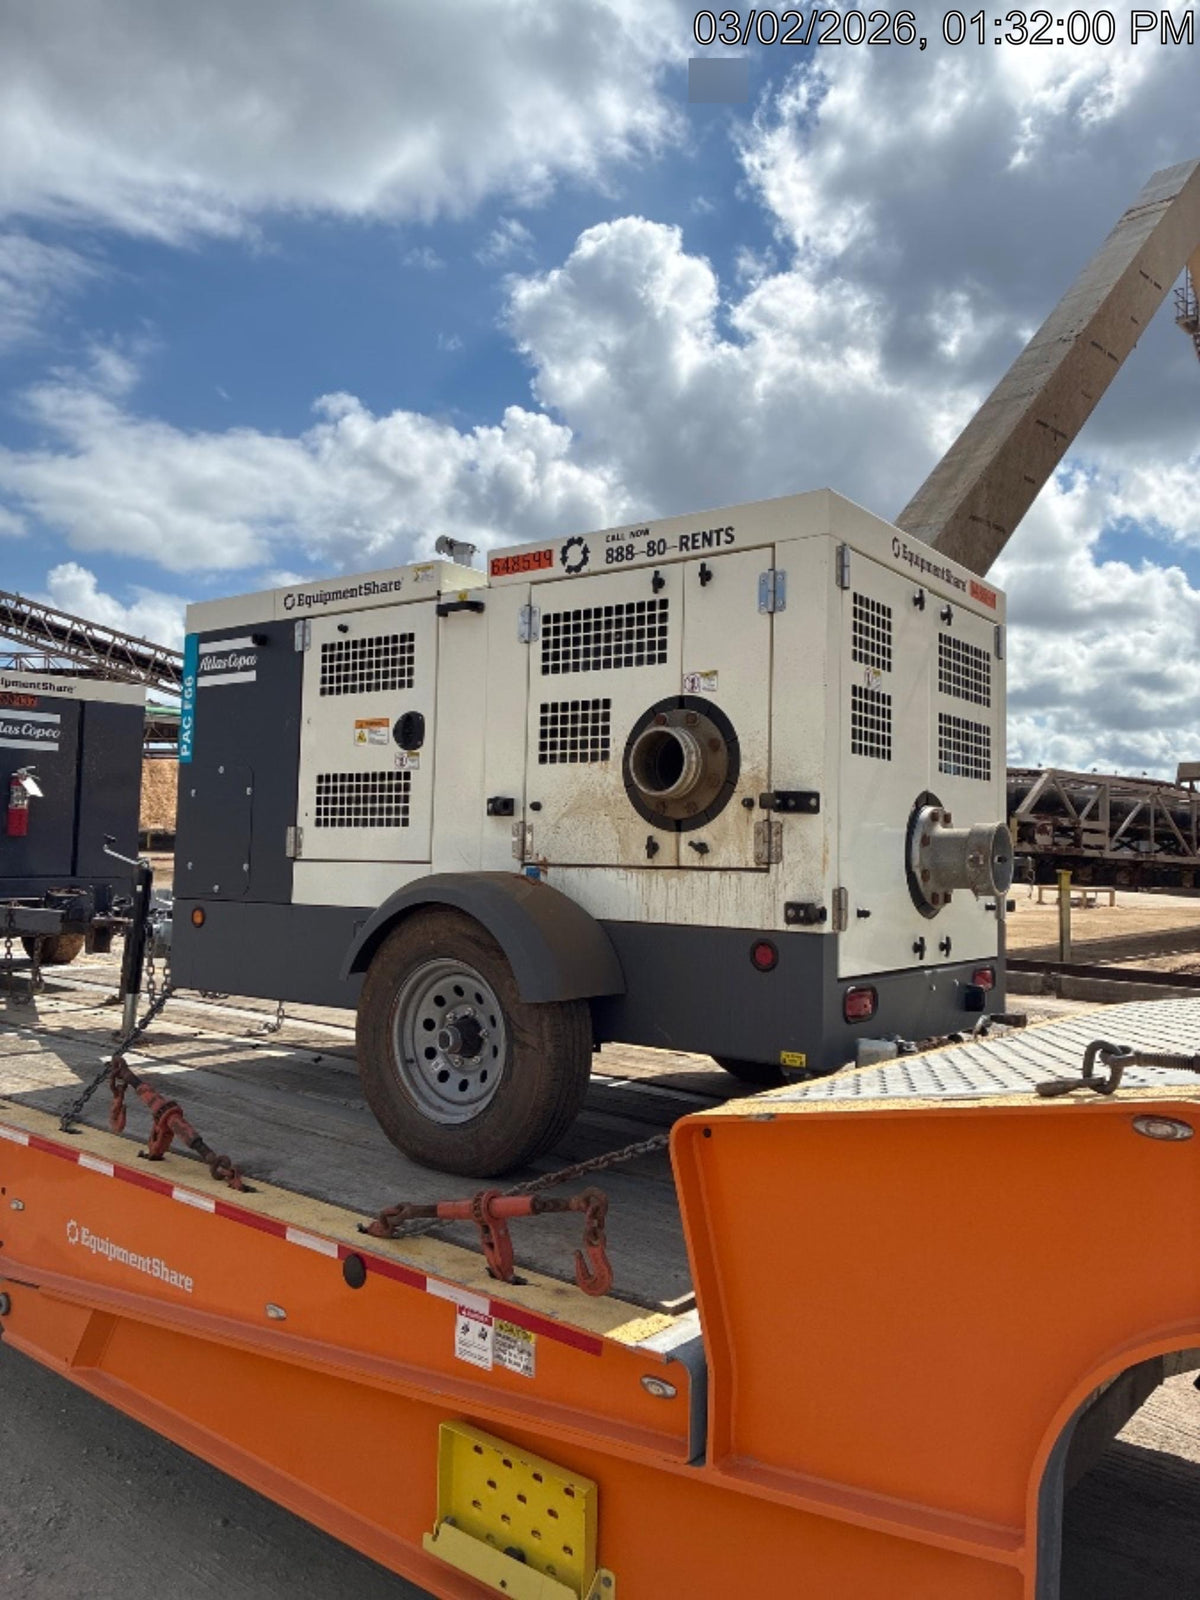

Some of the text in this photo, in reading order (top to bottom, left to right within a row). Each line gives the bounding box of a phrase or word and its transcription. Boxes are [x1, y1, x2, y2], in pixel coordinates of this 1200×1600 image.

[605, 527, 651, 543] CALL NOW
[297, 578, 402, 609] EquipmentShare
[198, 652, 258, 672] Atlas Copco
[21, 722, 61, 739] Copco
[180, 715, 193, 757] PAC
[80, 1226, 194, 1294] EquipmentShare
